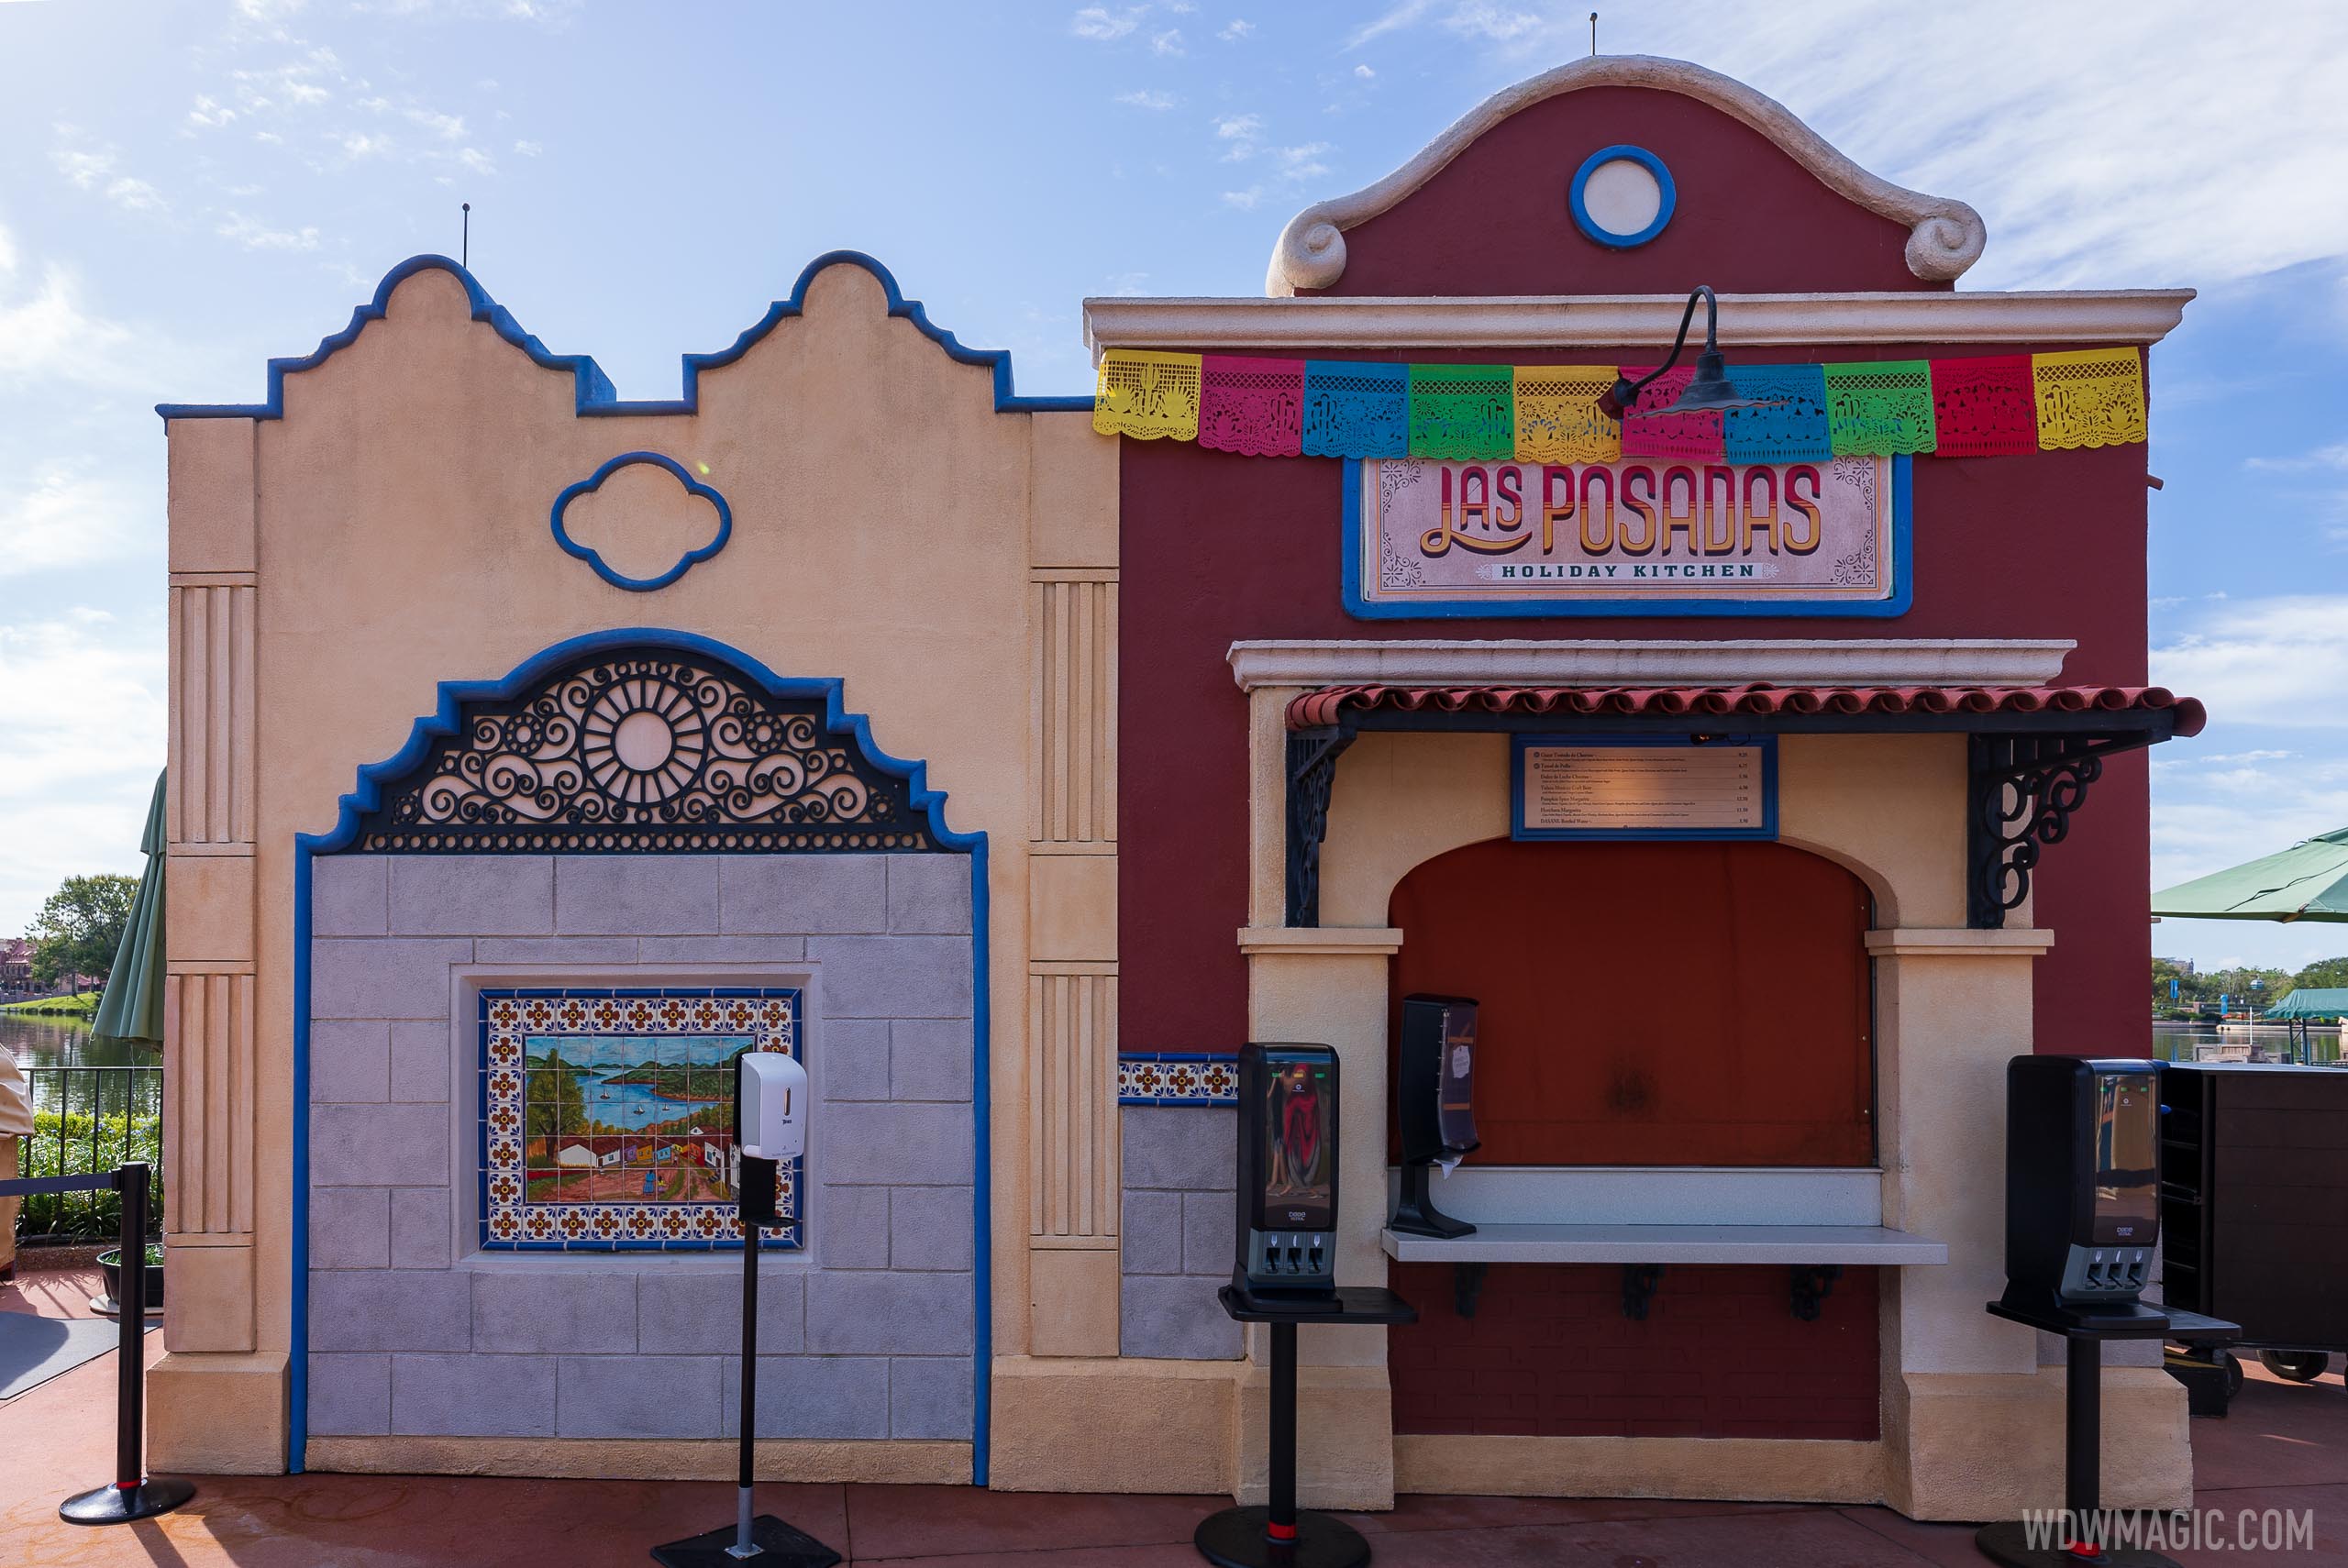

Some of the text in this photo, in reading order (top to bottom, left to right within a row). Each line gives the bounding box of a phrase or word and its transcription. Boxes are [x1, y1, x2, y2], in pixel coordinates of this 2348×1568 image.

[1420, 464, 1822, 558] LAS POSADAS
[1501, 564, 1755, 578] HOLIDAY KITCHEN
